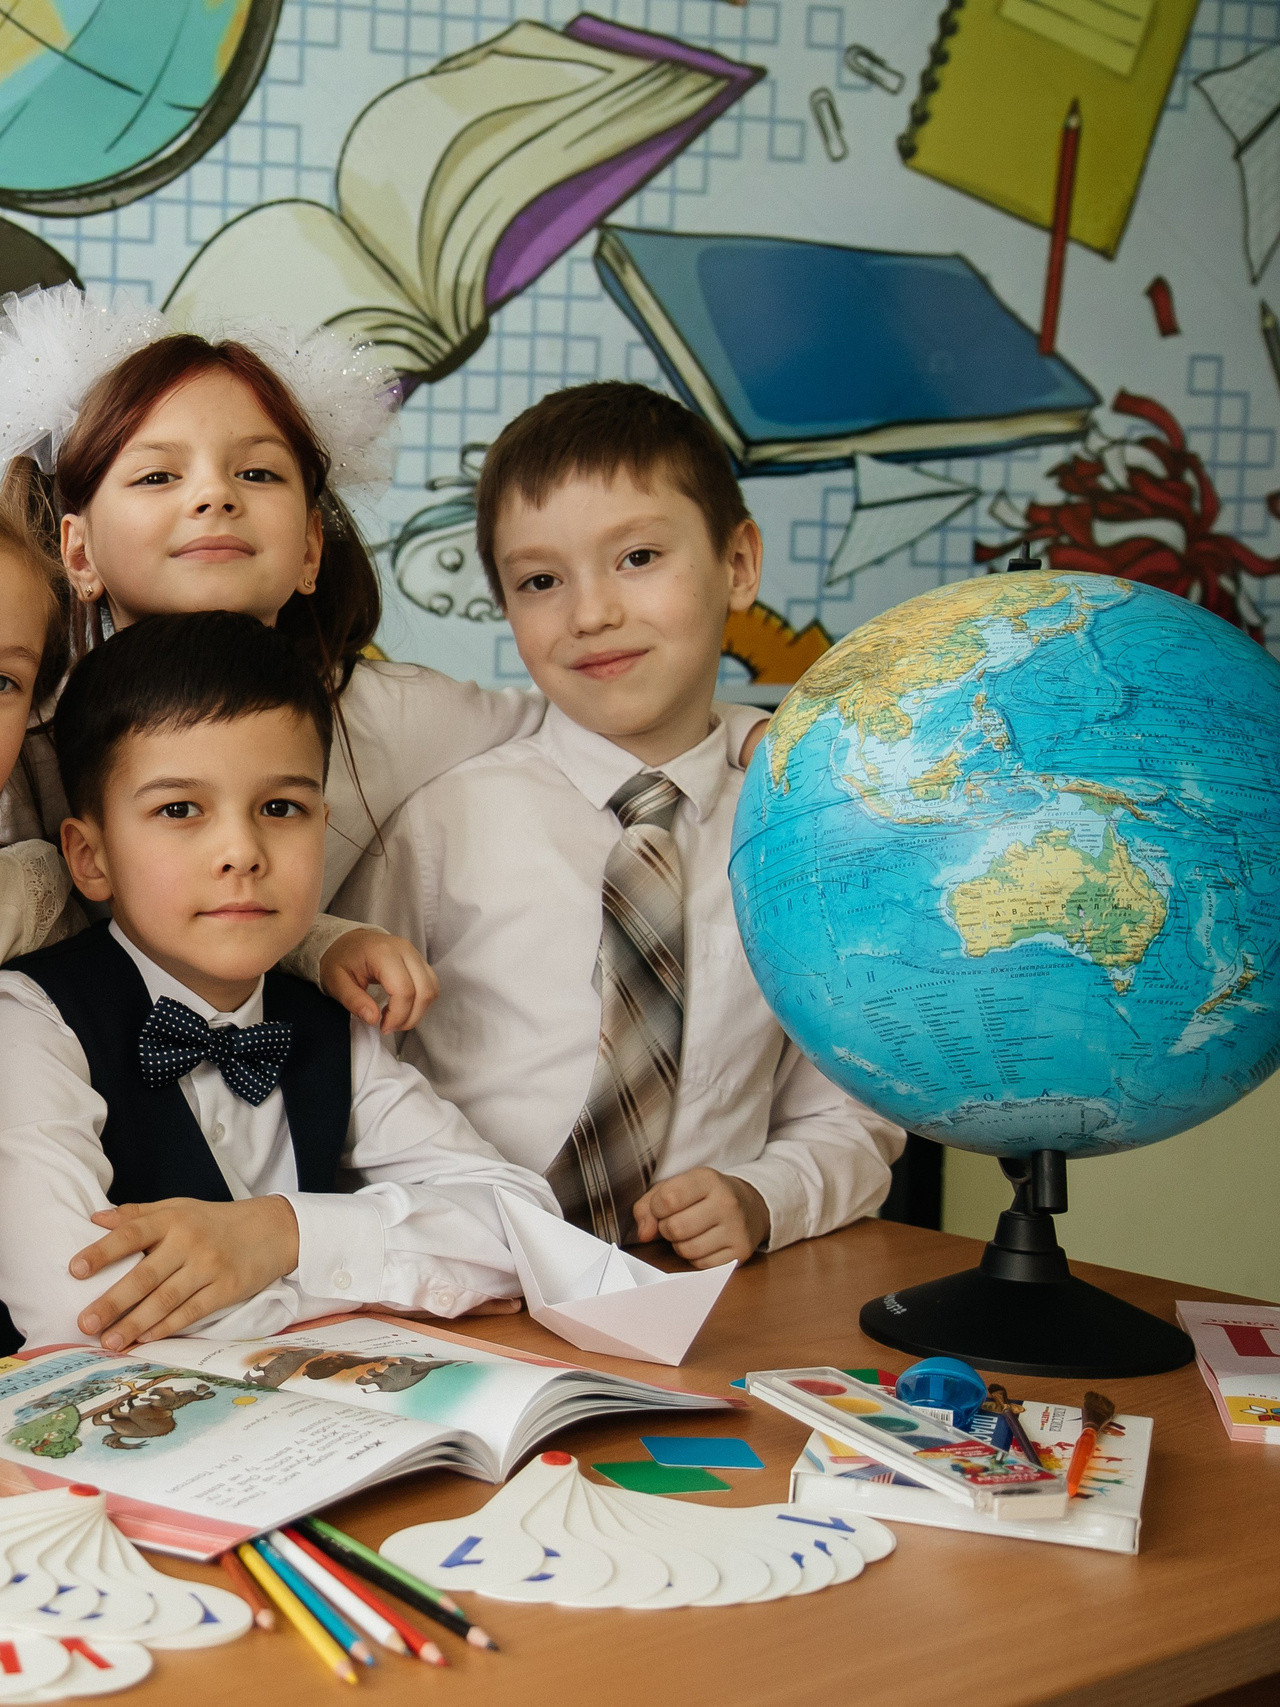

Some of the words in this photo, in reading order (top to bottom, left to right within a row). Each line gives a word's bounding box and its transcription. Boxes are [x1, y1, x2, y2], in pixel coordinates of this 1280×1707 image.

[995, 903, 1132, 918] АВСТРАЛИЯ
[990, 962, 1074, 974] Южно-Австралийская
[1010, 971, 1050, 979] котловина
[969, 1414, 999, 1444] ПЛАС
[346, 1439, 386, 1461] Жучка
